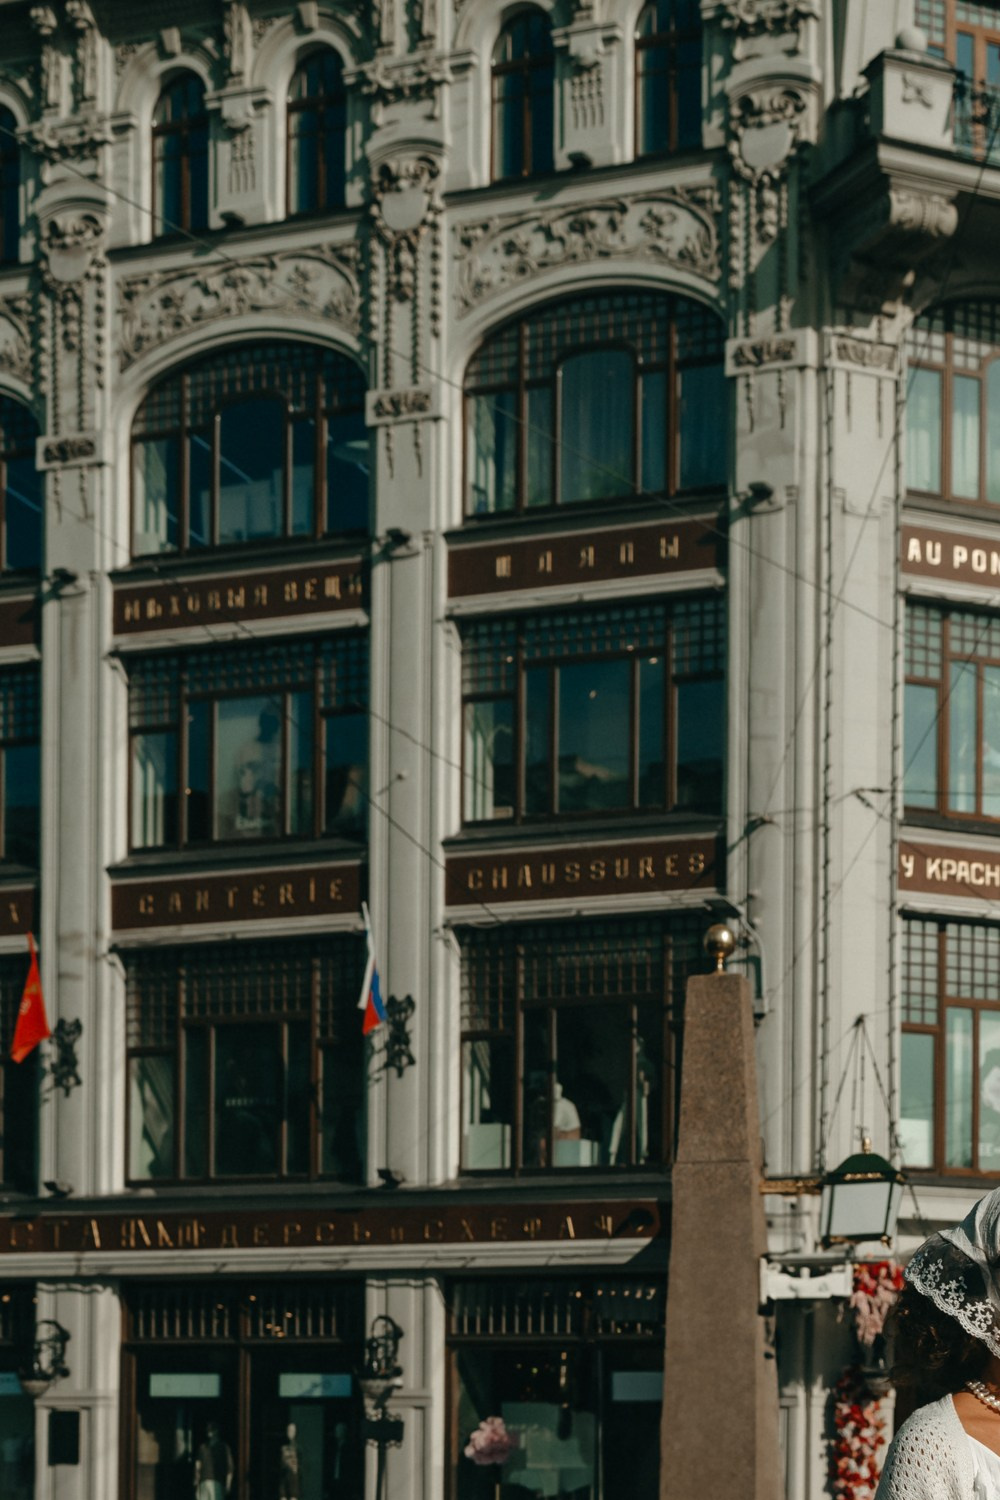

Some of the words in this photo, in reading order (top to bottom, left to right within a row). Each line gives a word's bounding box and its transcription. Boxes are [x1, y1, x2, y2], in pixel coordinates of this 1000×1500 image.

[907, 538, 942, 566] AU
[467, 852, 705, 890] CHAUSSURES
[901, 854, 915, 878] У
